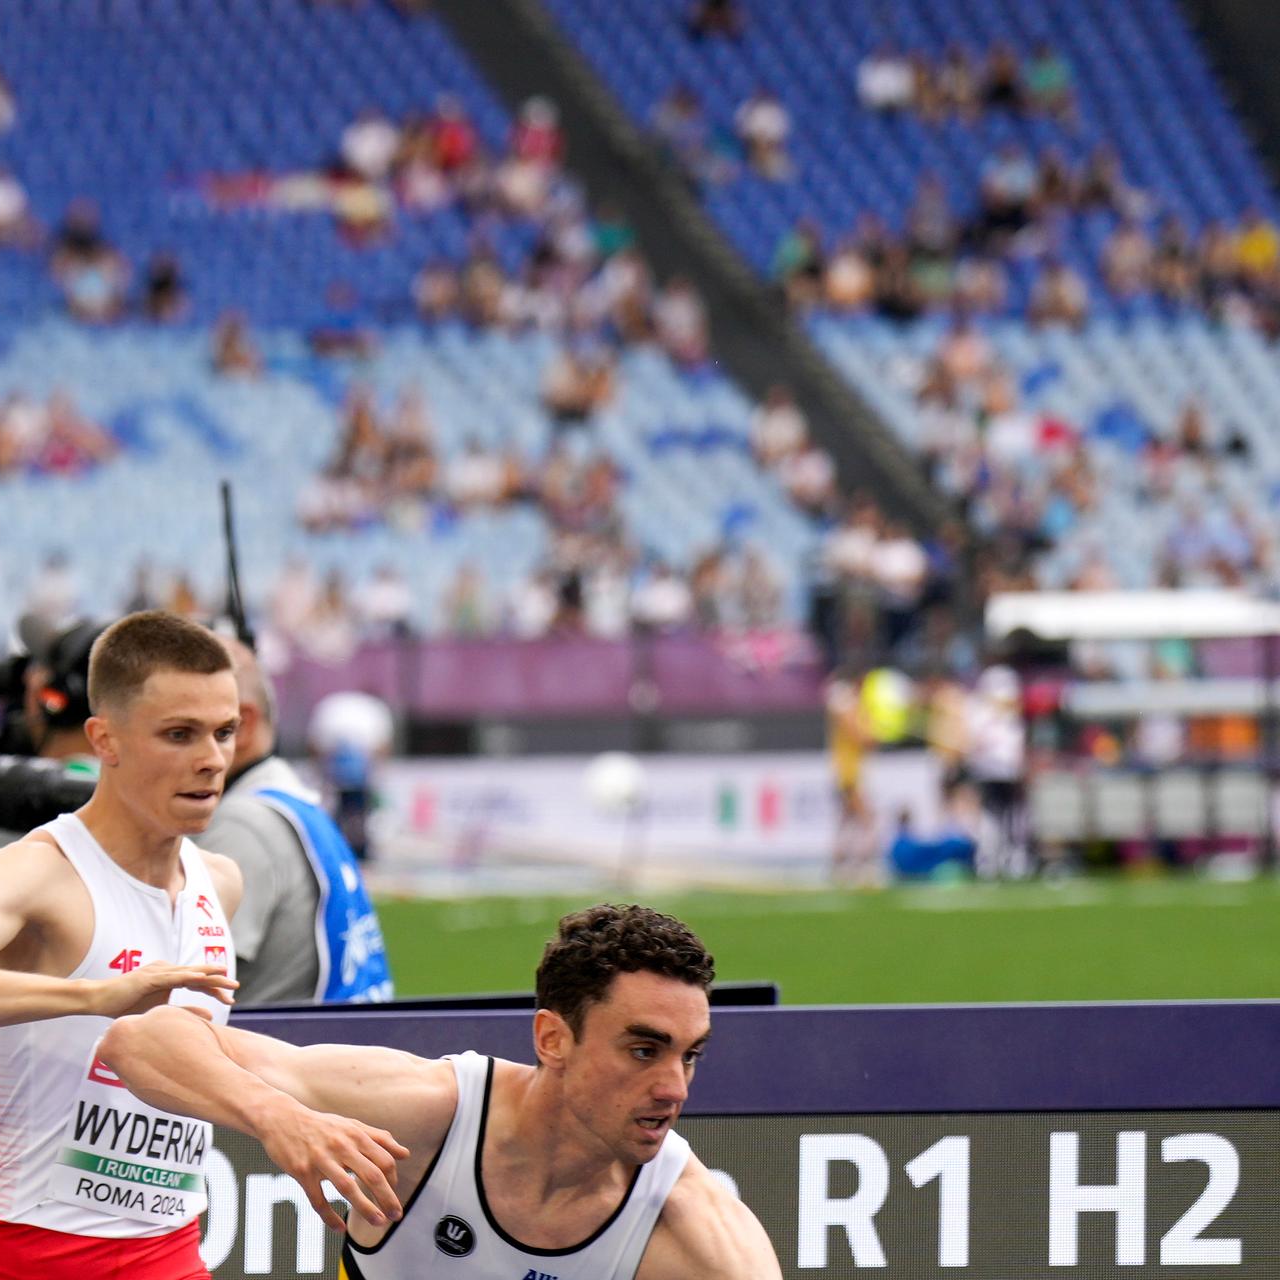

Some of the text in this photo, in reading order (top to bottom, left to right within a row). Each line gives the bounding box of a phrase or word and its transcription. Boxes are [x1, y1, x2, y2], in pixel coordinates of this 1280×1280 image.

[108, 949, 142, 974] 4F
[73, 1100, 206, 1166] WYDERKA
[105, 1161, 141, 1181] RUN
[75, 1178, 186, 1217] ROMA 2024
[797, 1133, 971, 1268] R1
[1048, 1131, 1243, 1267] H2
